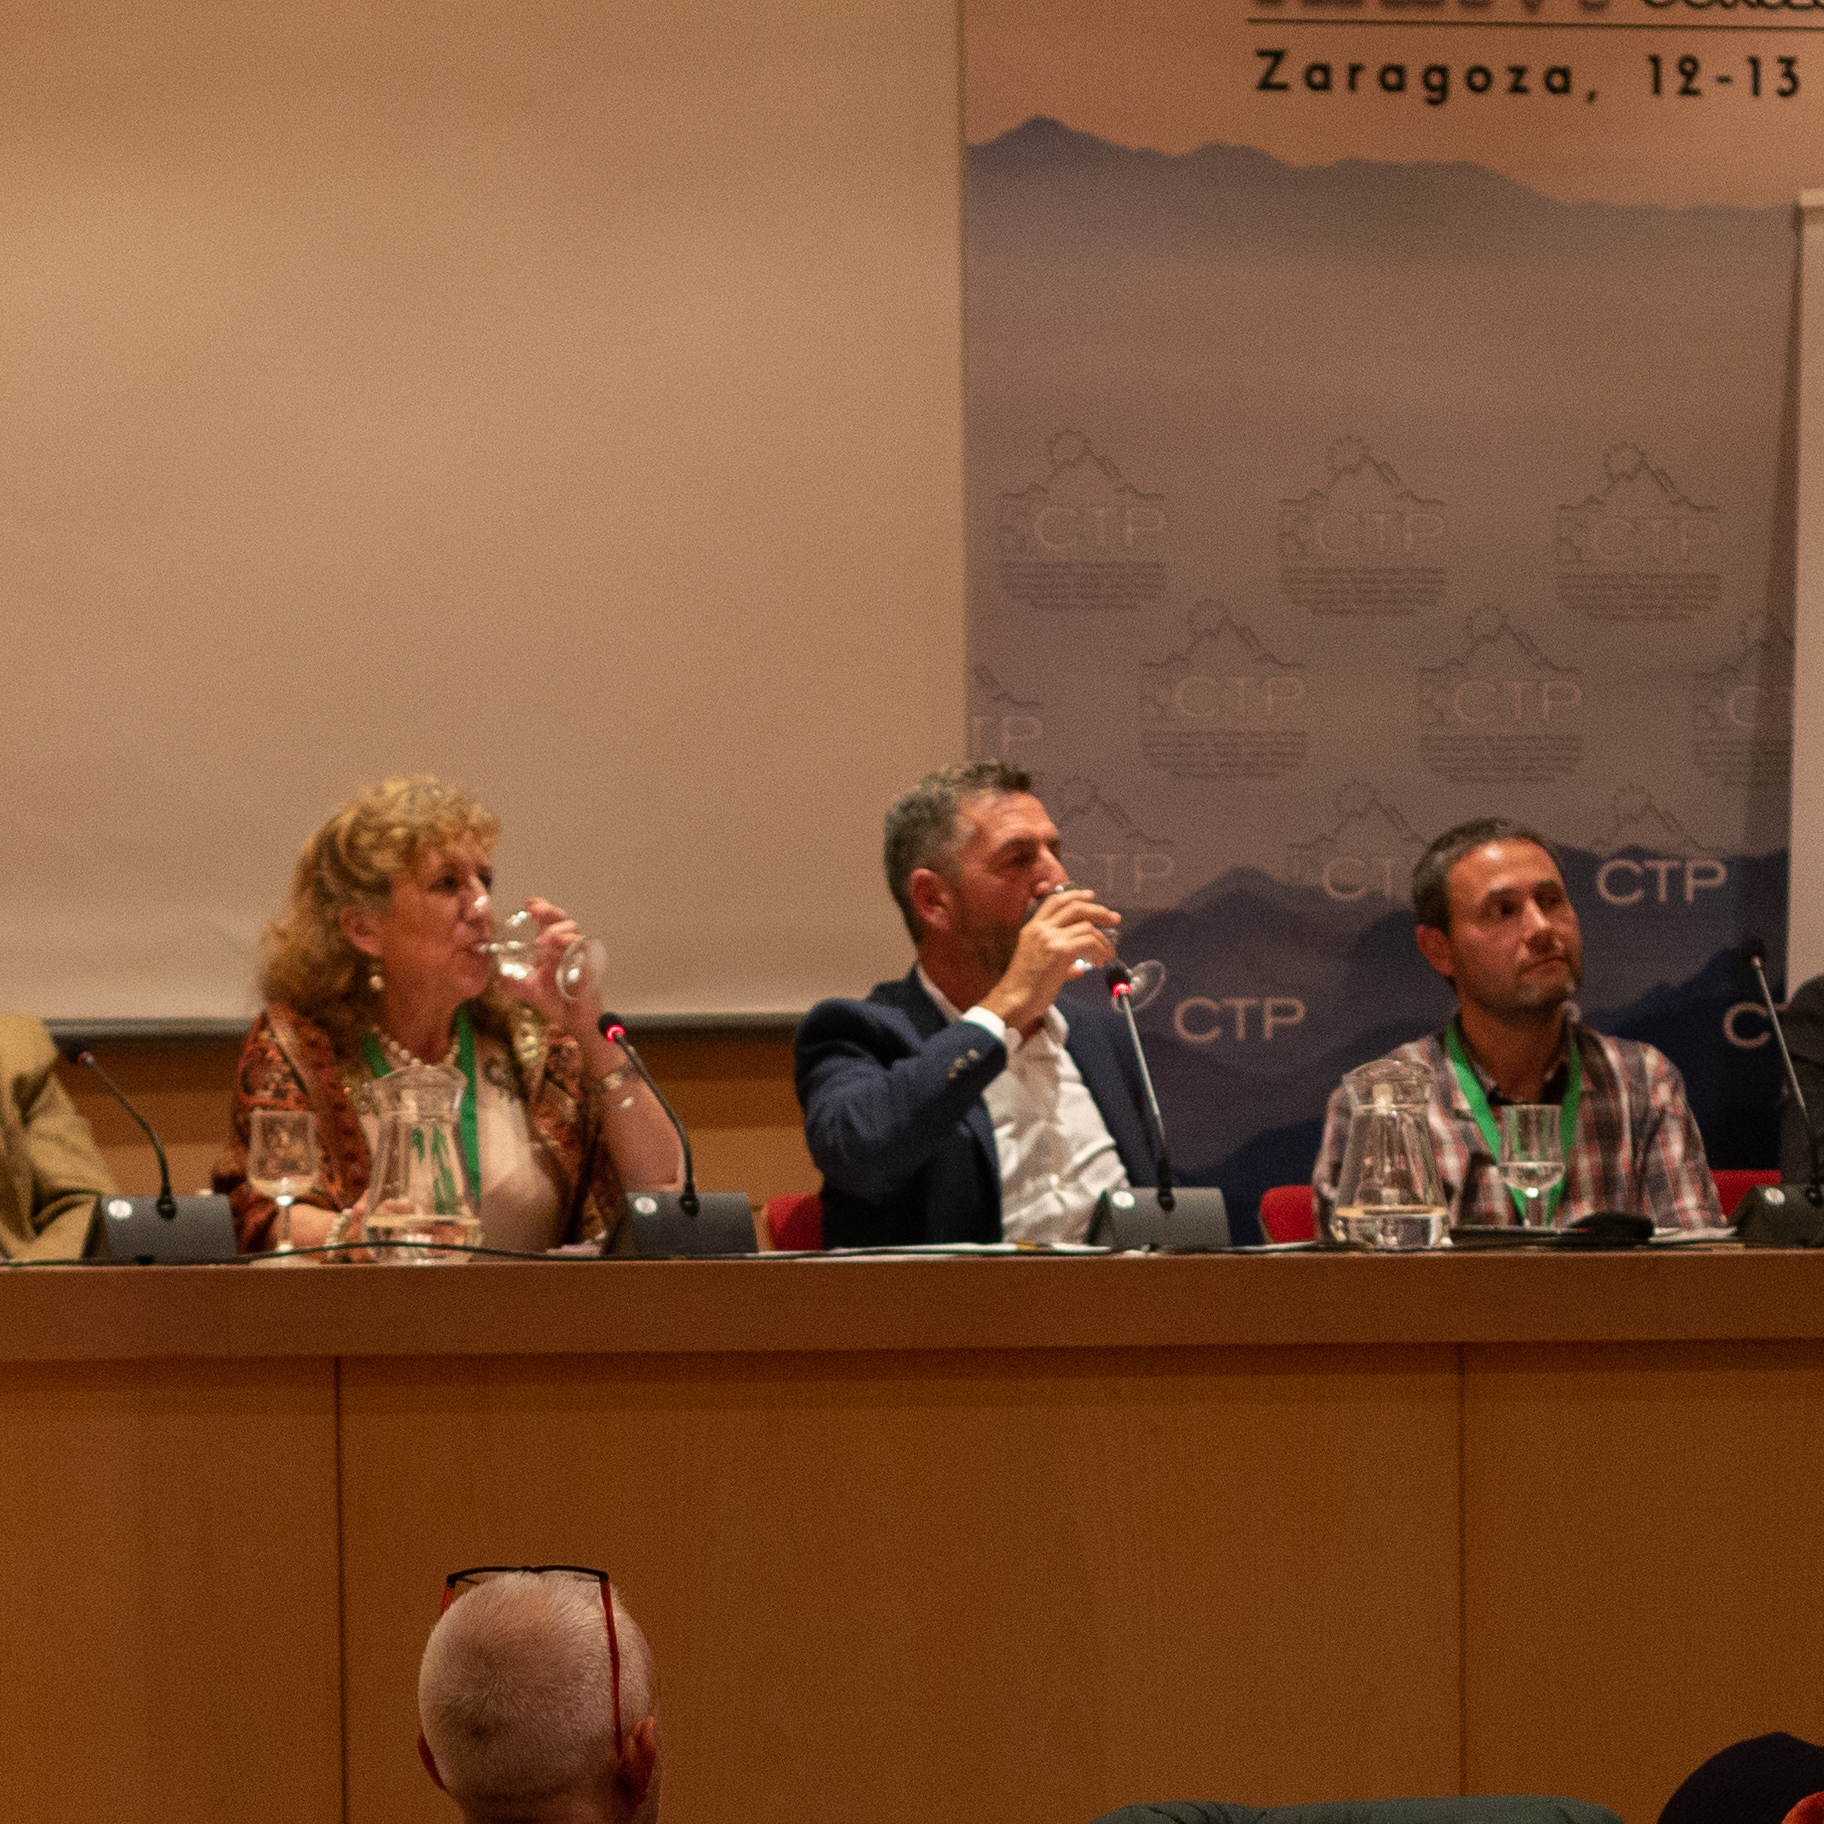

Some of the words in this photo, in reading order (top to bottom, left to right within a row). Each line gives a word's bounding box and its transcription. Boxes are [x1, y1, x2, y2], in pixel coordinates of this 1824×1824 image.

[1255, 48, 1597, 106] Zaragoza,
[1646, 53, 1800, 99] 12-13
[1032, 505, 1169, 551] CTP
[1314, 511, 1445, 555] CTP
[1589, 516, 1721, 562] CTP
[1171, 674, 1307, 719] CTP
[1451, 680, 1583, 725] CTP
[970, 714, 1043, 757] TP
[1061, 853, 1175, 894] TP
[1322, 855, 1406, 901] CT
[1596, 859, 1726, 905] CTP
[1171, 994, 1307, 1045] CTP
